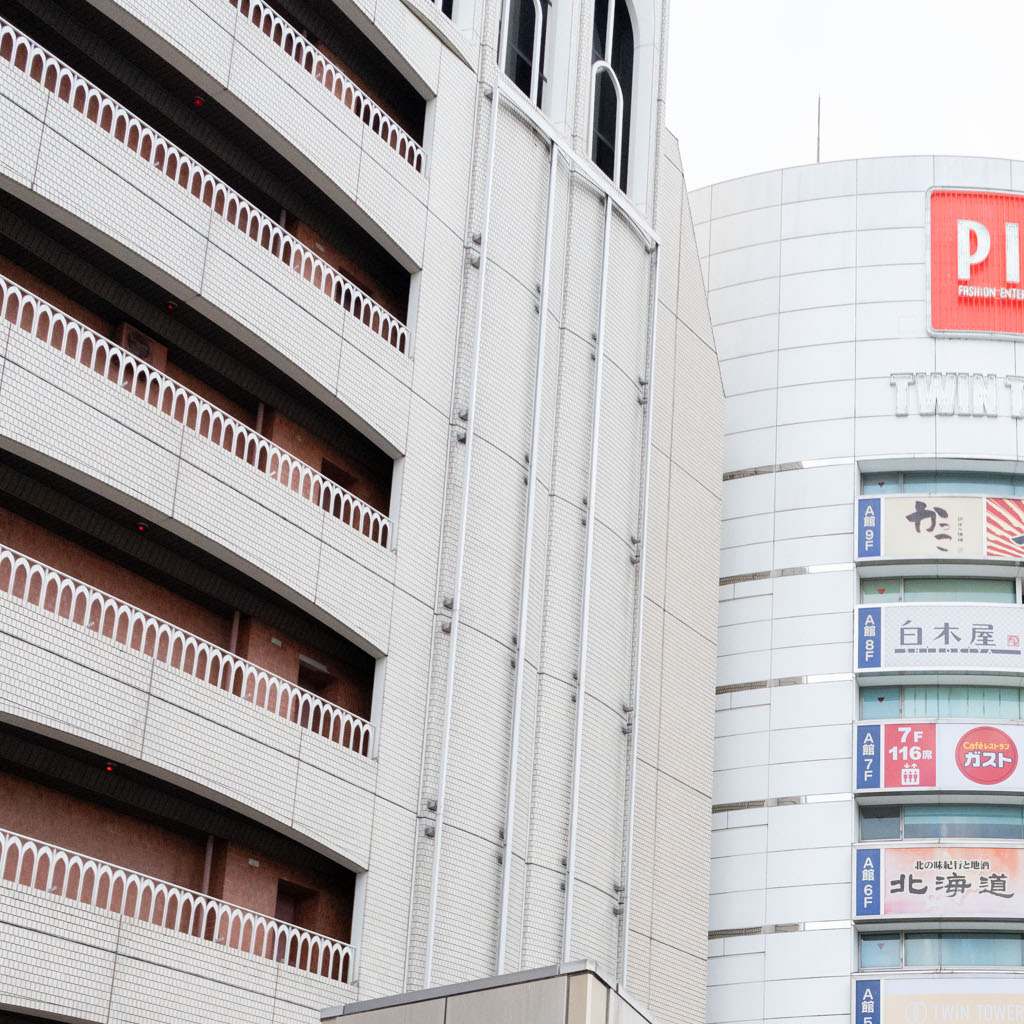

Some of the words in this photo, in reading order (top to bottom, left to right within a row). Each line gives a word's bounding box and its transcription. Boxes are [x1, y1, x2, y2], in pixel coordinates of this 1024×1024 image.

[958, 285, 996, 299] FASHION
[890, 372, 998, 418] TWIN
[900, 619, 996, 646] 白木屋
[898, 727, 923, 742] 7F
[888, 746, 932, 761] 116席
[964, 751, 1013, 768] ガスト
[914, 860, 990, 871] 北の味紀行と地酒
[890, 873, 1015, 899] 北海道
[933, 1005, 969, 1021] TWIN
[977, 1005, 1024, 1022] TOWER
